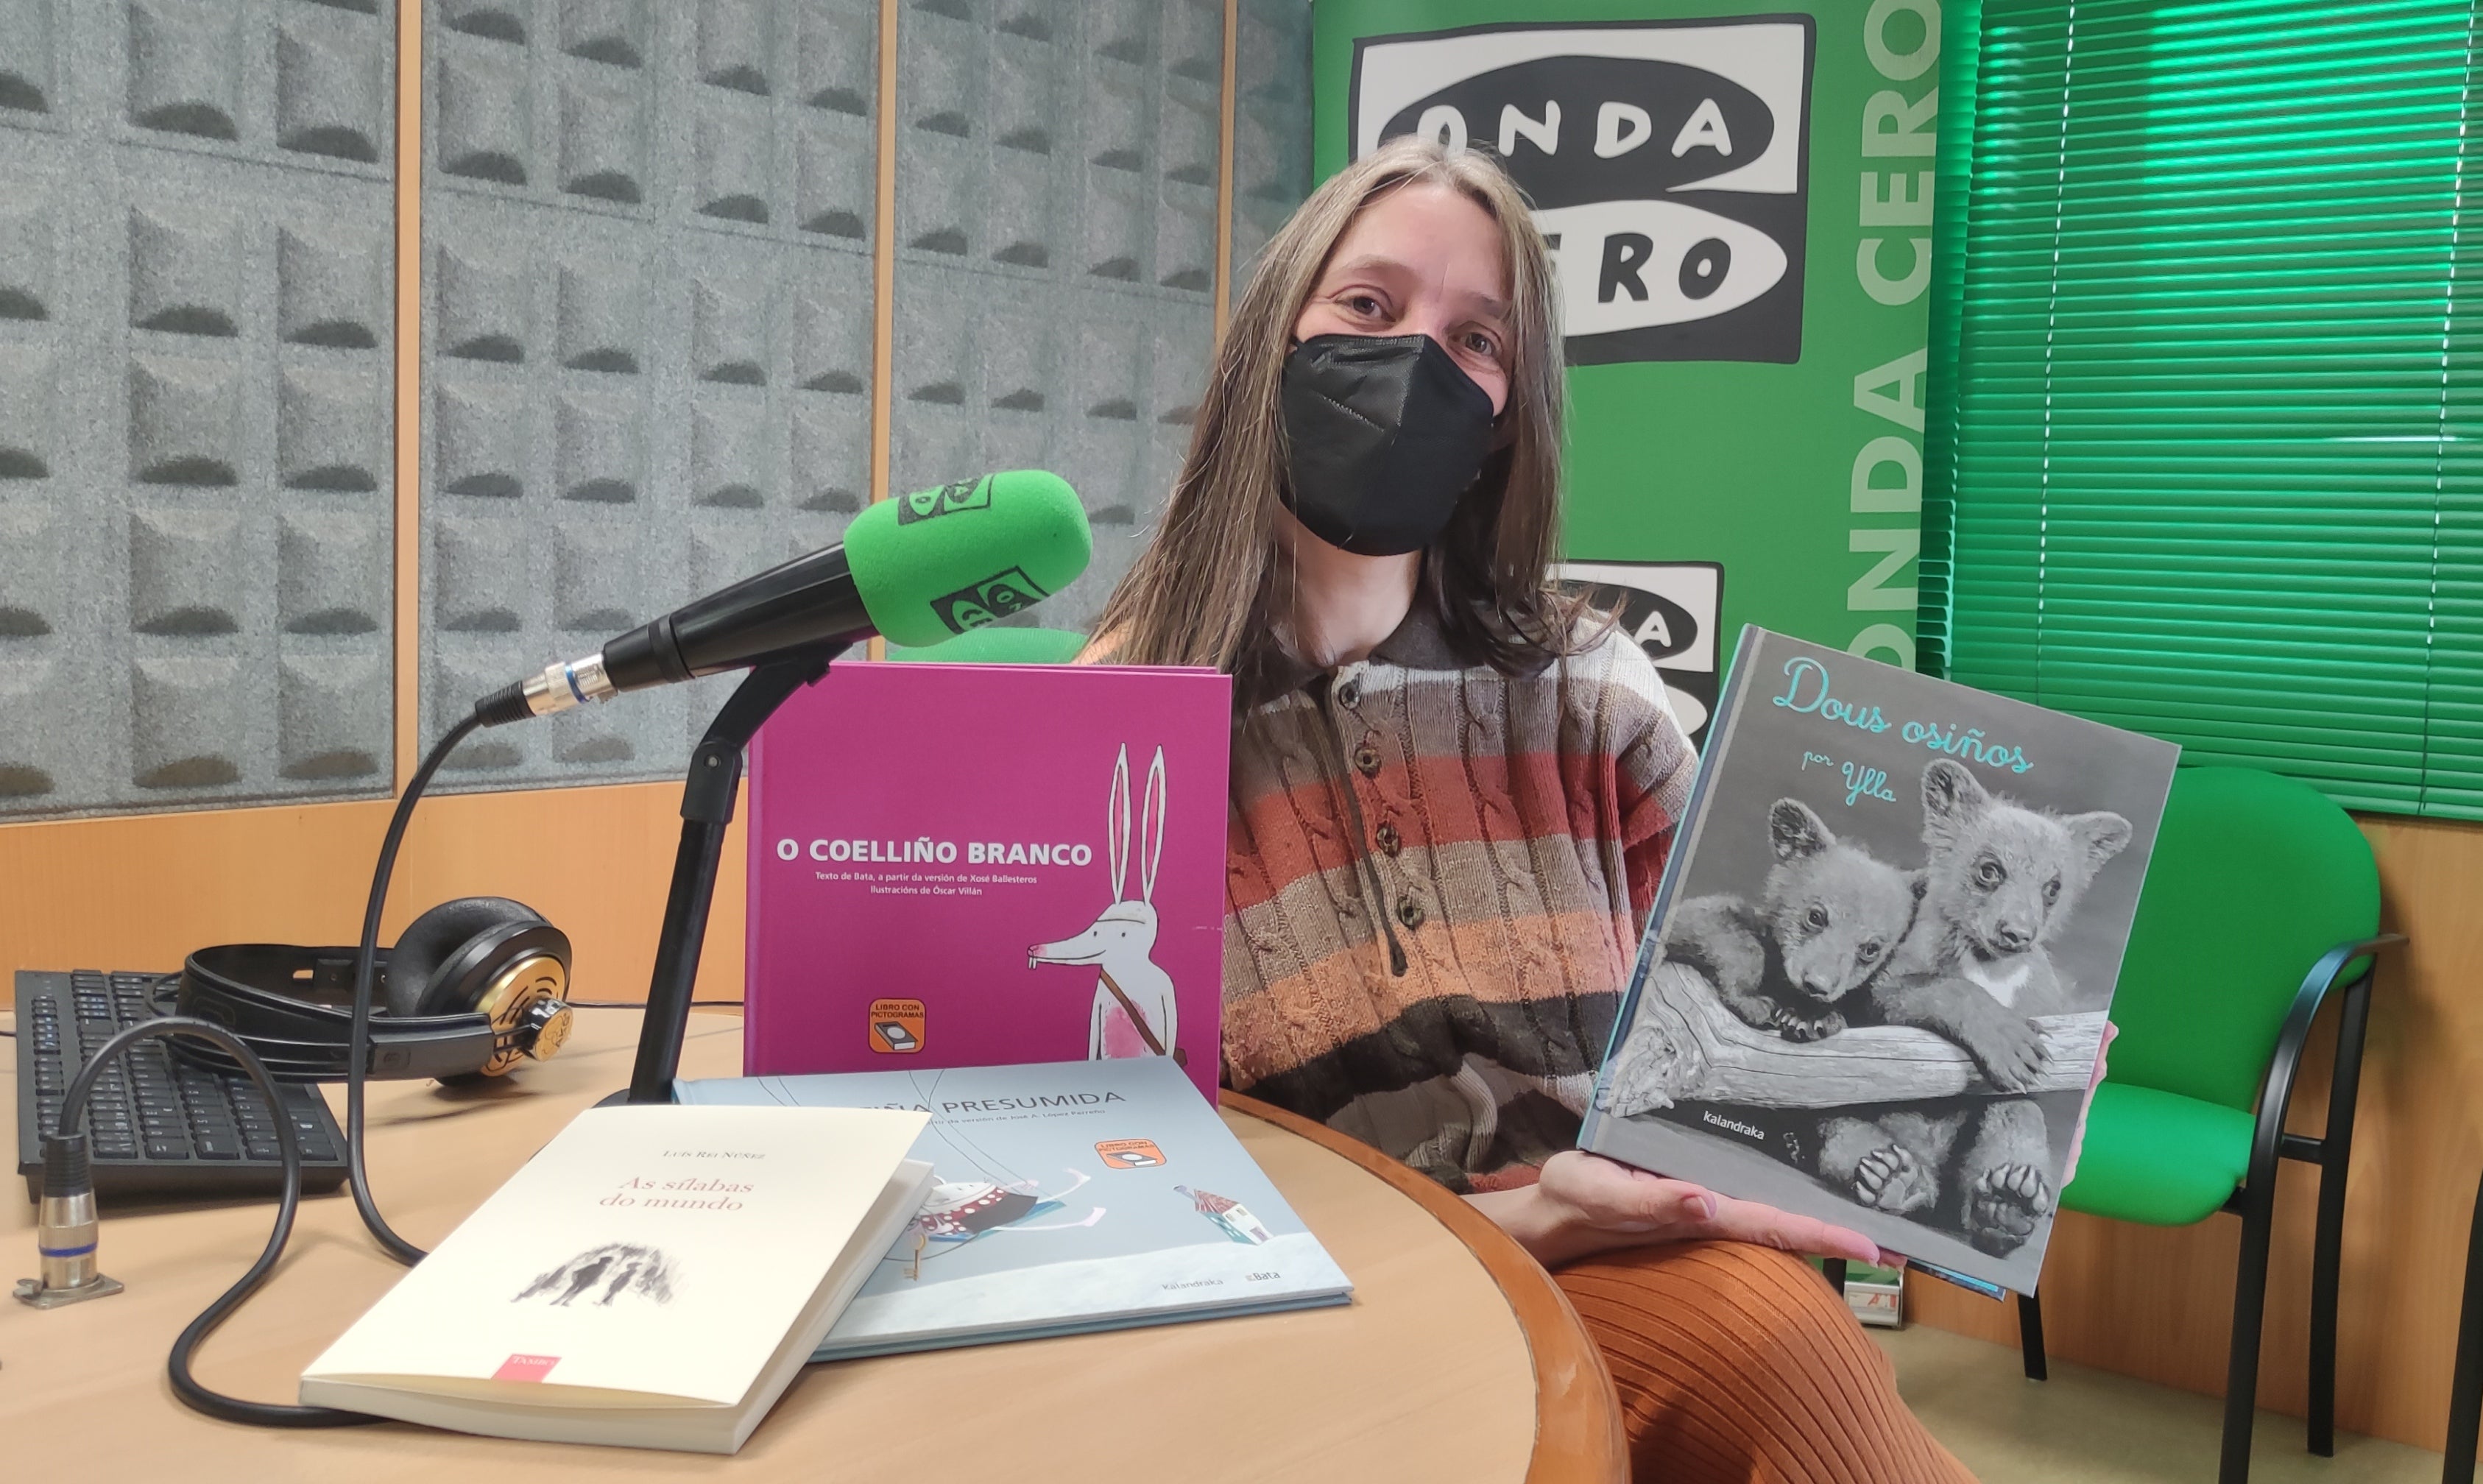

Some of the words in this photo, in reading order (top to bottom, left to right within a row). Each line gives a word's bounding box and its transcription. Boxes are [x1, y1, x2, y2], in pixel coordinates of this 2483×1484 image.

[1417, 99, 1732, 161] ONDA
[1856, 0, 1942, 306] CERO
[1773, 657, 1892, 733] Dous
[1902, 721, 2034, 774] osiños
[1802, 751, 1834, 771] por
[1842, 761, 1896, 806] Ylla
[777, 838, 799, 861] O
[809, 836, 957, 864] COELLIÑO
[967, 841, 1092, 866] BRANCO
[815, 871, 838, 881] Texto
[841, 872, 852, 881] de
[854, 872, 875, 883] Bata,
[877, 874, 883, 882] a
[885, 872, 908, 883] partir
[911, 872, 922, 882] da
[924, 873, 955, 883] versión
[957, 874, 968, 883] de
[969, 873, 990, 883] Xosé
[992, 874, 1038, 885] Ballesteros
[870, 885, 919, 895] Ilustracións
[920, 886, 931, 895] de
[933, 885, 956, 896] Óscar
[958, 885, 983, 896] Villán
[871, 1011, 924, 1019] PICTOGRAMAS
[875, 1003, 900, 1011] LIBRO
[902, 1003, 919, 1011] CON
[942, 1092, 1127, 1114] PRESUMIDA
[618, 1176, 657, 1190] As
[662, 1177, 755, 1193] sílabas
[598, 1192, 636, 1207] do
[643, 1195, 744, 1211] mundo
